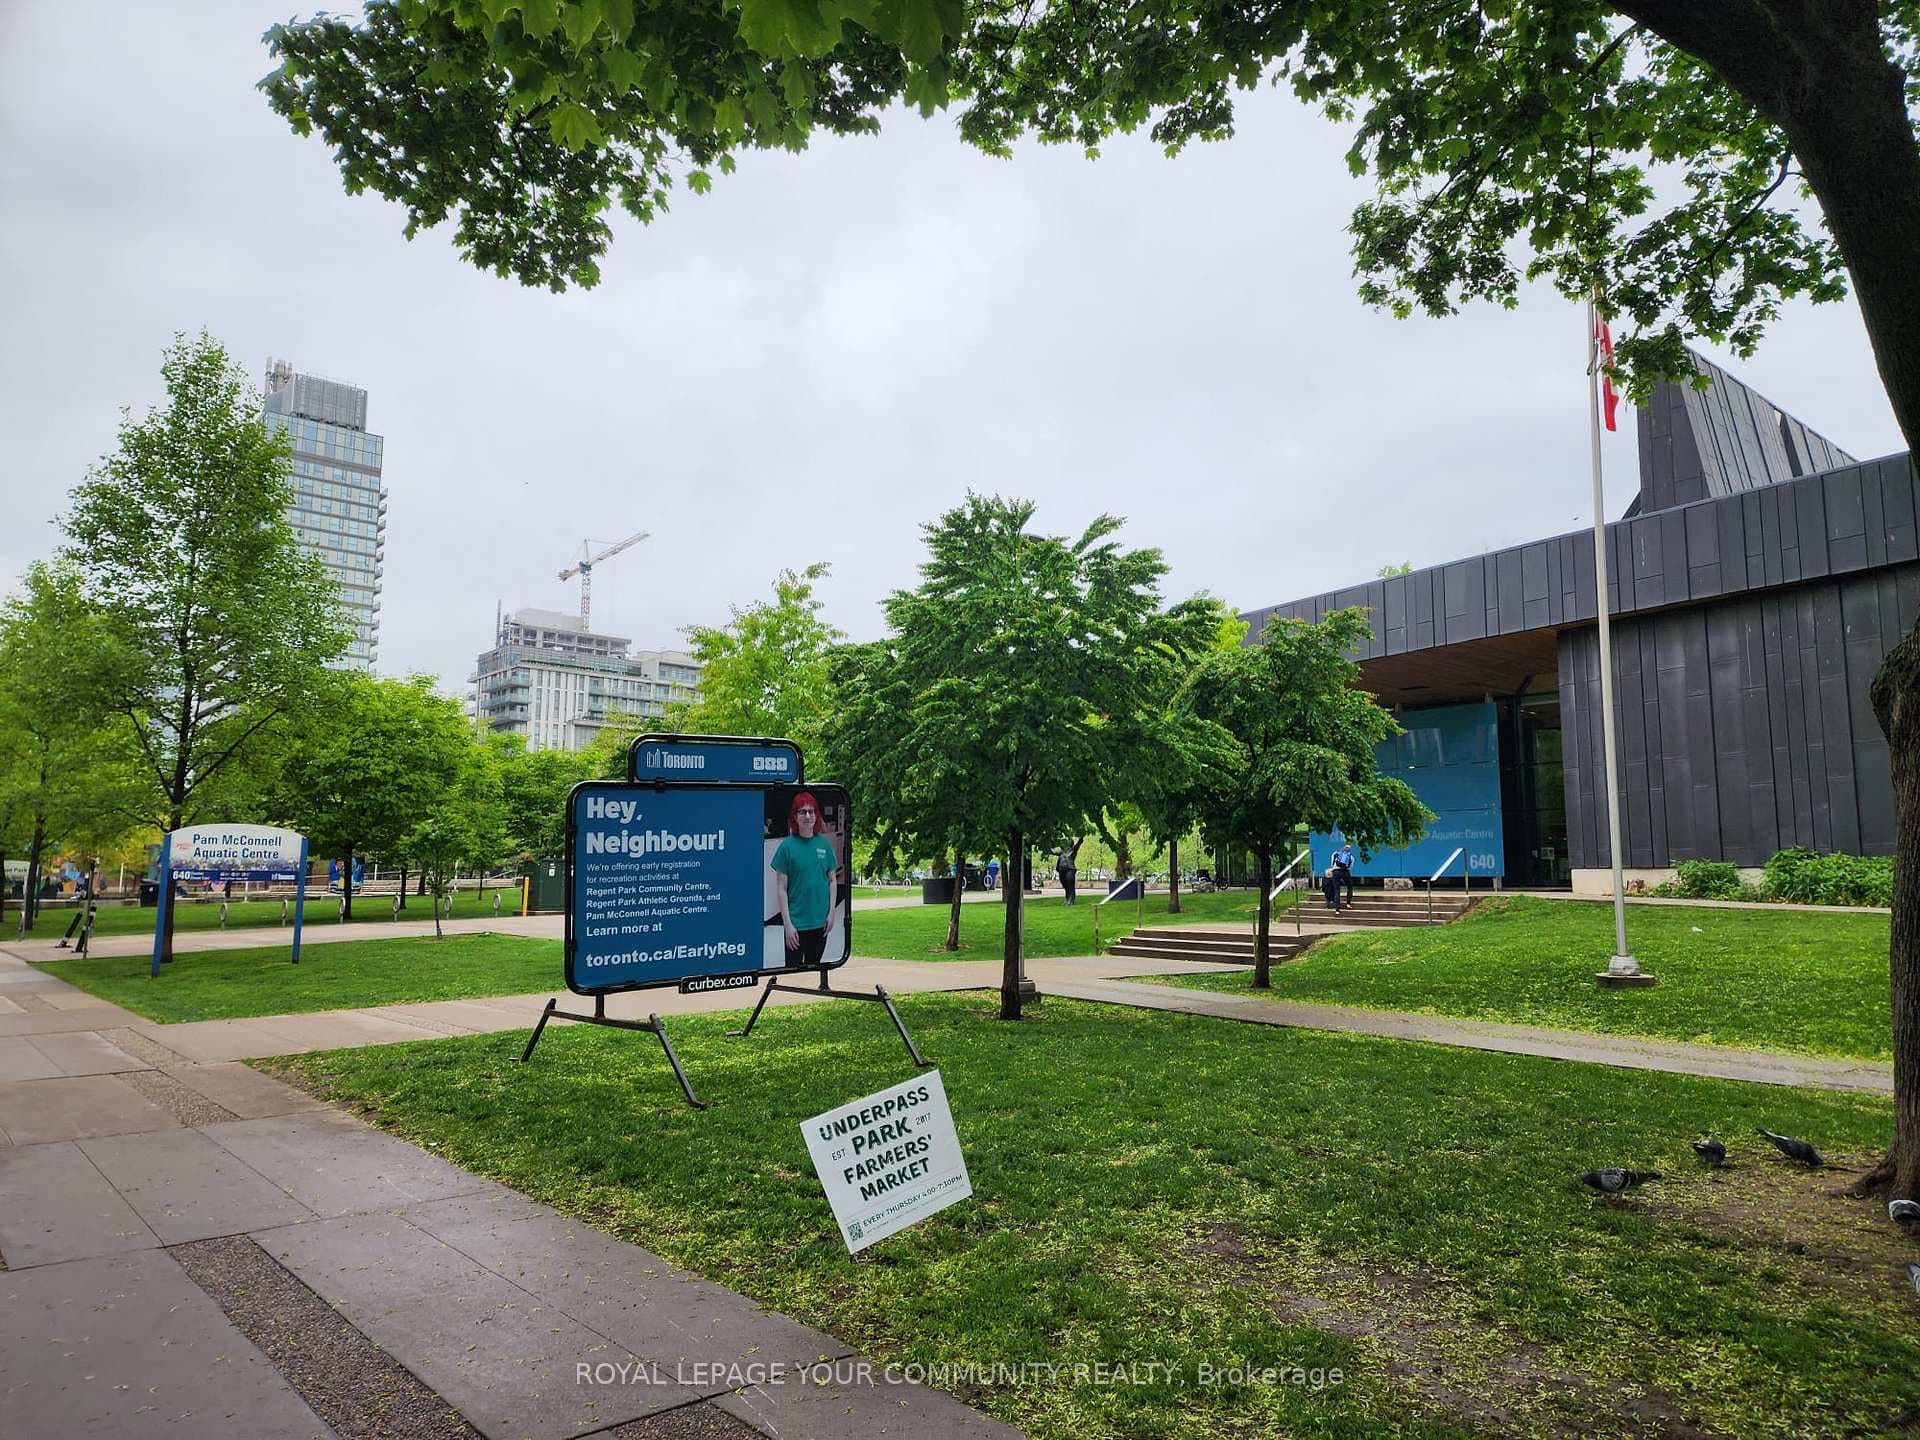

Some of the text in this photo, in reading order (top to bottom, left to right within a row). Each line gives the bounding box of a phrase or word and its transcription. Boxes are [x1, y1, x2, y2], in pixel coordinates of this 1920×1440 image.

[662, 751, 705, 769] TORONTO
[587, 797, 643, 824] Hey,
[193, 834, 281, 846] Pam McConnell
[586, 830, 725, 858] Neighbour!
[193, 847, 279, 859] Aquatic Centre
[586, 860, 701, 873] We're offering early registration
[1469, 854, 1495, 869] 640
[172, 871, 190, 880] 640
[586, 872, 679, 884] for recreation activities at
[586, 882, 712, 897] Regent Park Community Centre,
[586, 893, 721, 909] Regent Park Athletic Grounds, and
[586, 906, 710, 920] Pam McConnell Aquatic Centre.
[586, 922, 662, 937] Learn more at
[586, 941, 746, 967] toronto.ca/EarlyReg
[688, 975, 753, 991] curbex.com
[819, 1086, 929, 1141] UNDERPASS
[831, 1112, 932, 1161] EST PARK 2017
[843, 1134, 932, 1184] FARMERS'
[860, 1157, 930, 1201] MARKET
[863, 1212, 884, 1227] EVERY
[886, 1193, 921, 1215] THURSDAY
